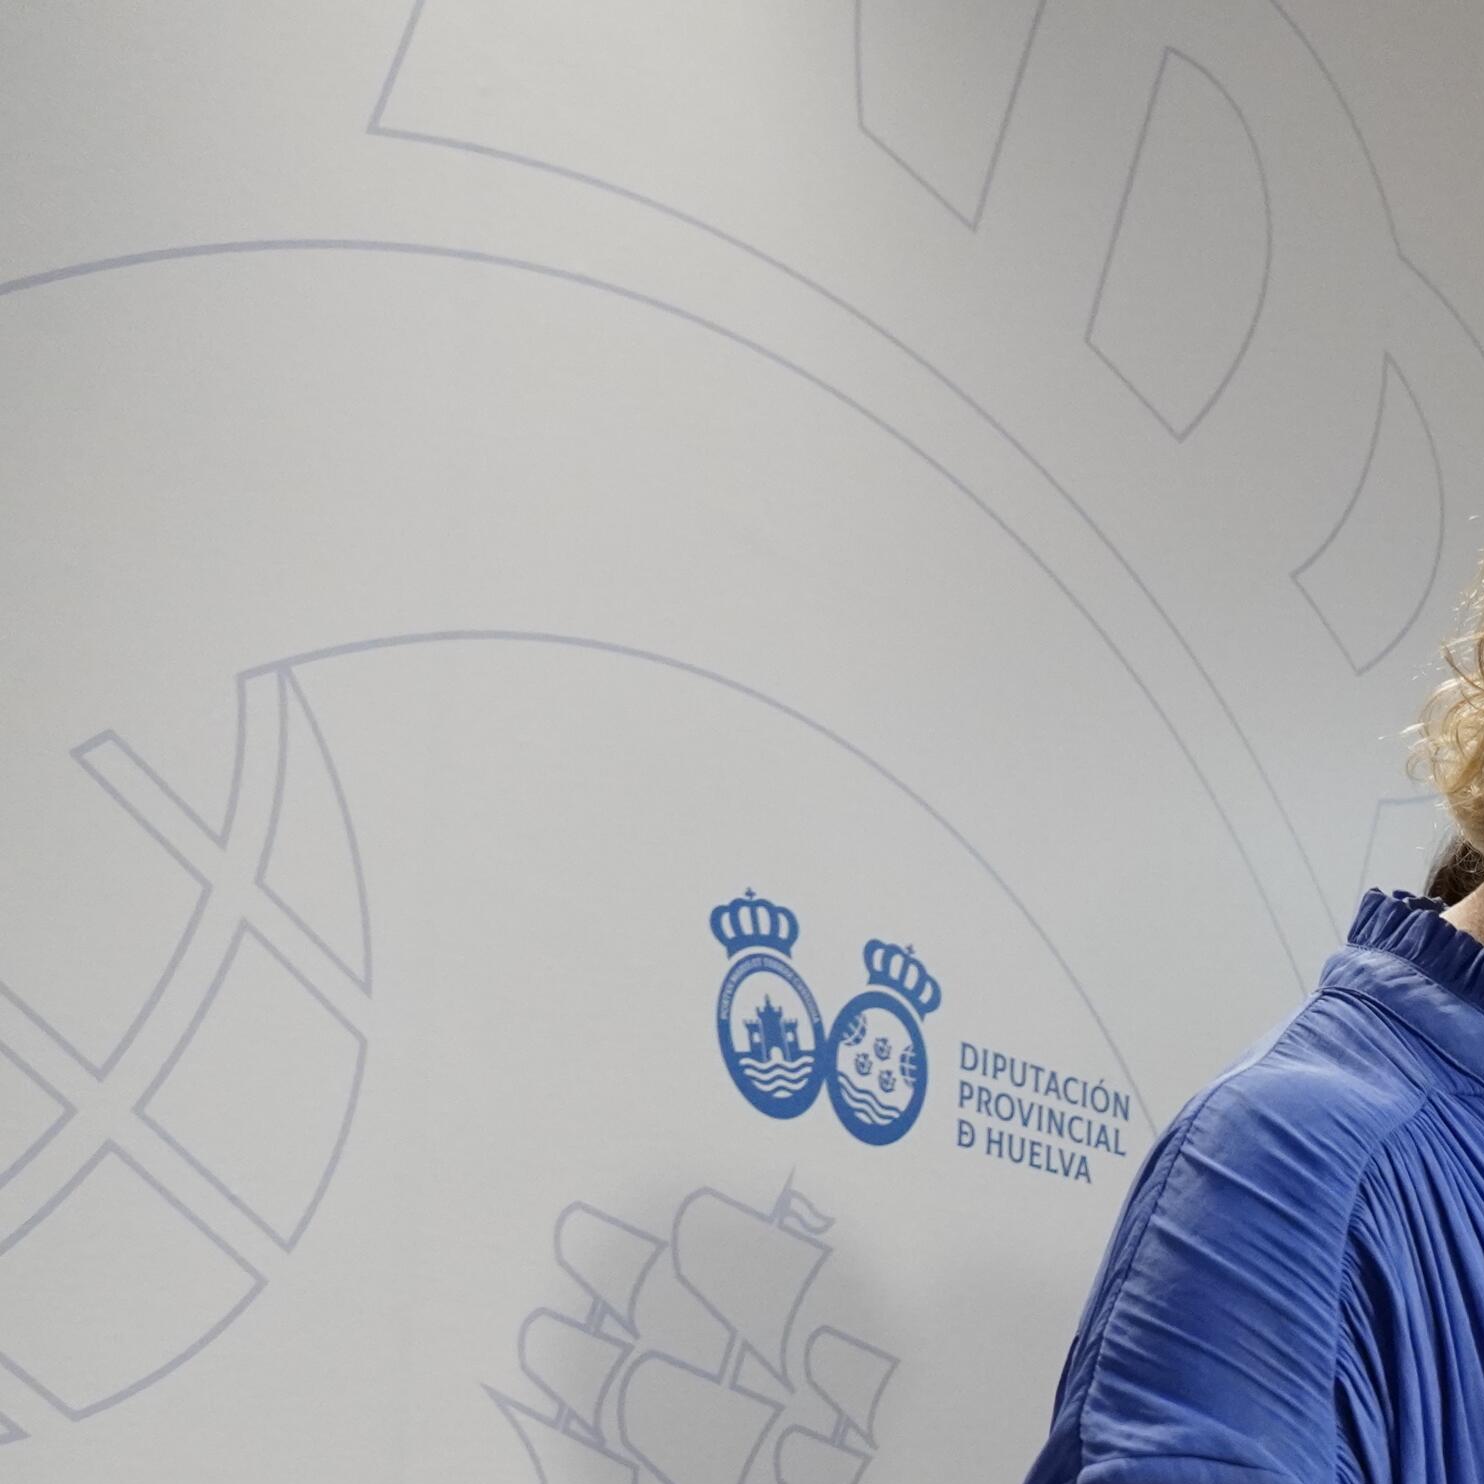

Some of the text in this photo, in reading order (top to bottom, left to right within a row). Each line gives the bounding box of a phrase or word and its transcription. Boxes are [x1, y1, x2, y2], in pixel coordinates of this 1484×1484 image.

[958, 1080, 1127, 1157] PROVINCIAL
[960, 1041, 1131, 1122] DIPUTACIÓN
[985, 1127, 1093, 1184] HUELVA
